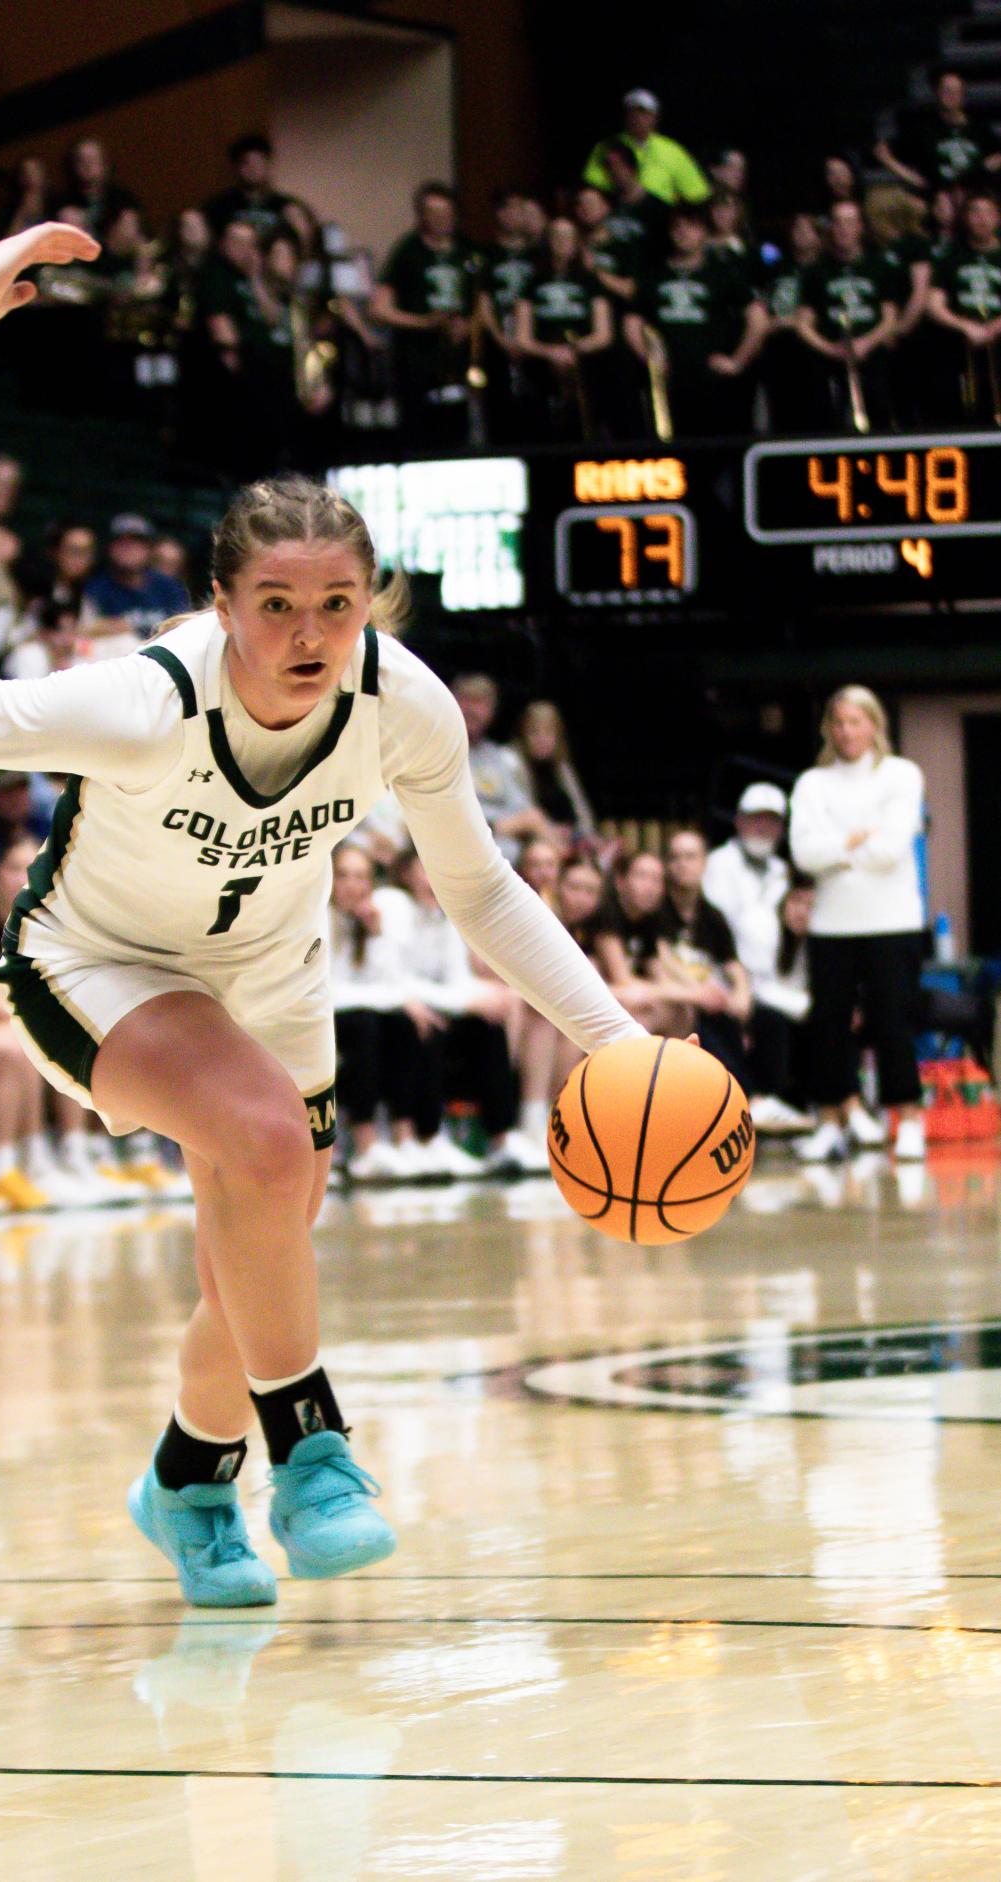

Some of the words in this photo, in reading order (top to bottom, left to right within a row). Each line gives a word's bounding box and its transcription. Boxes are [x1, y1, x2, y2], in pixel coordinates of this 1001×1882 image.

[574, 457, 687, 503] RAMS
[807, 446, 969, 523] 4:48
[901, 538, 933, 579] 4
[162, 798, 355, 849] COLORADO
[197, 836, 313, 869] STATE
[206, 875, 264, 936] 1
[709, 1109, 753, 1175] Wil
